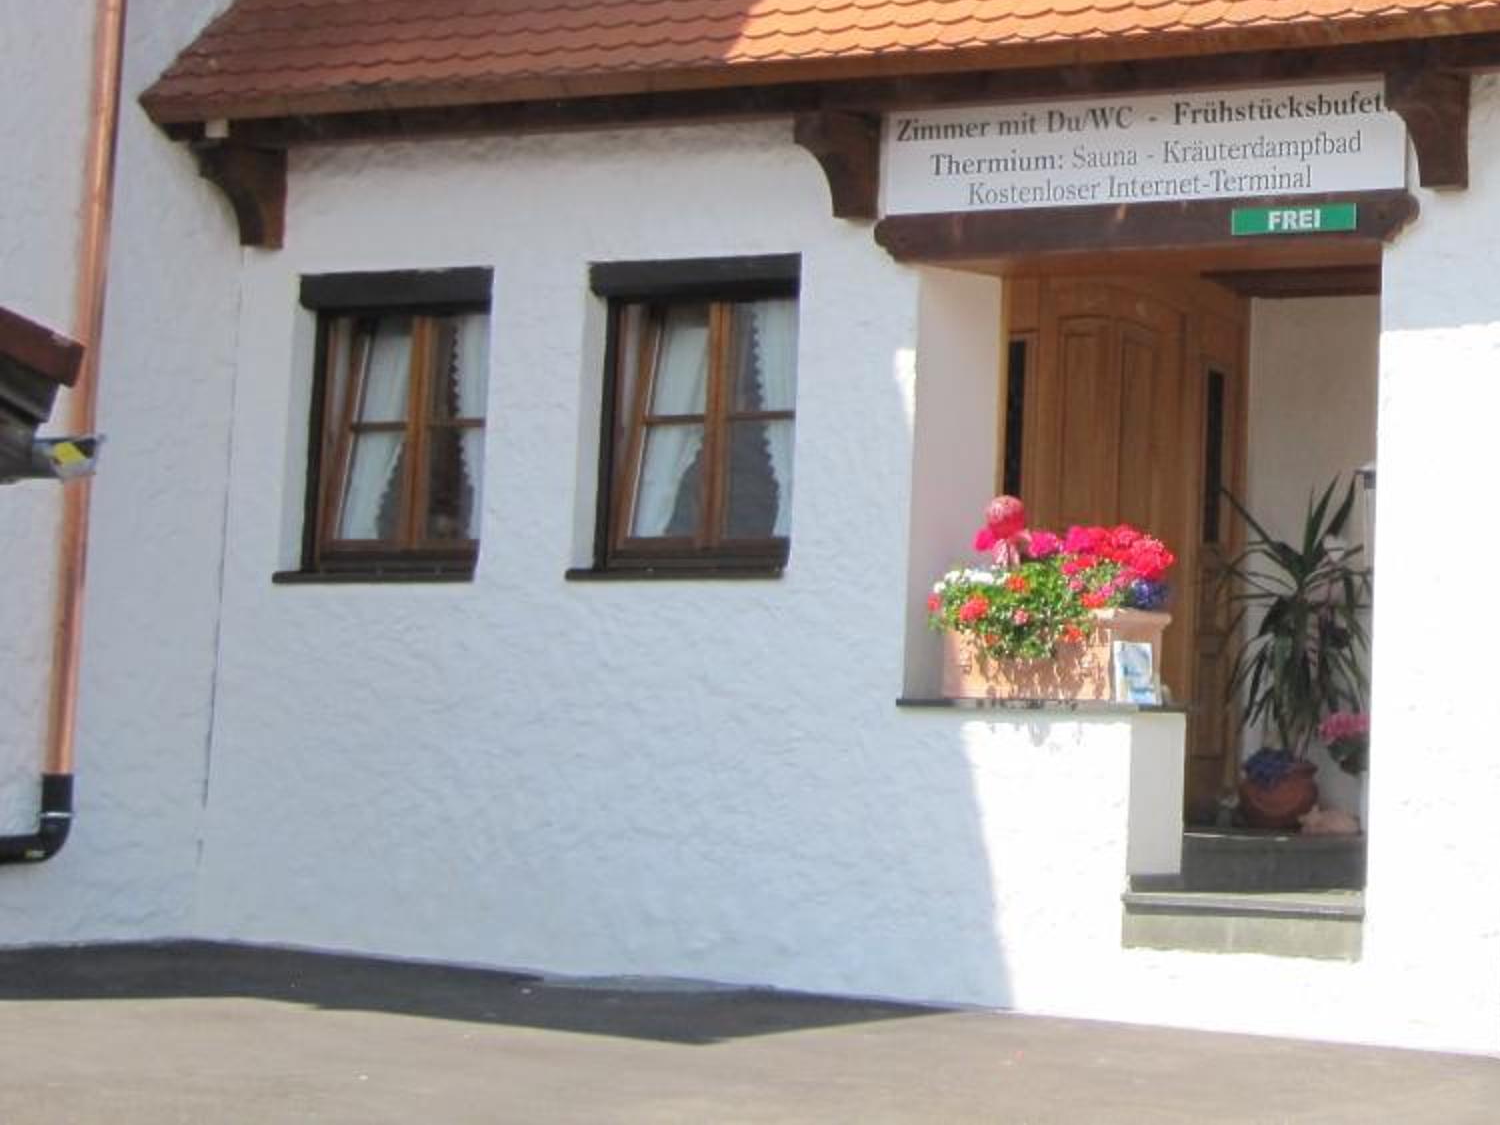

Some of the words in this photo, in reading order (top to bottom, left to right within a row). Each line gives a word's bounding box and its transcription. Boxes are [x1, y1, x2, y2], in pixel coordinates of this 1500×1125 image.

[897, 117, 990, 142] Zimmer
[999, 111, 1036, 136] mit
[1049, 105, 1133, 133] Du/WC
[1174, 90, 1391, 125] Frühstücksbufet
[930, 149, 1063, 176] Thermium:
[1072, 145, 1138, 169] Sauna
[1163, 129, 1362, 165] Kräuterdampfbad
[968, 178, 1101, 206] Kostenloser
[1109, 165, 1312, 199] Internet-Terminal
[1268, 208, 1321, 231] FREI
